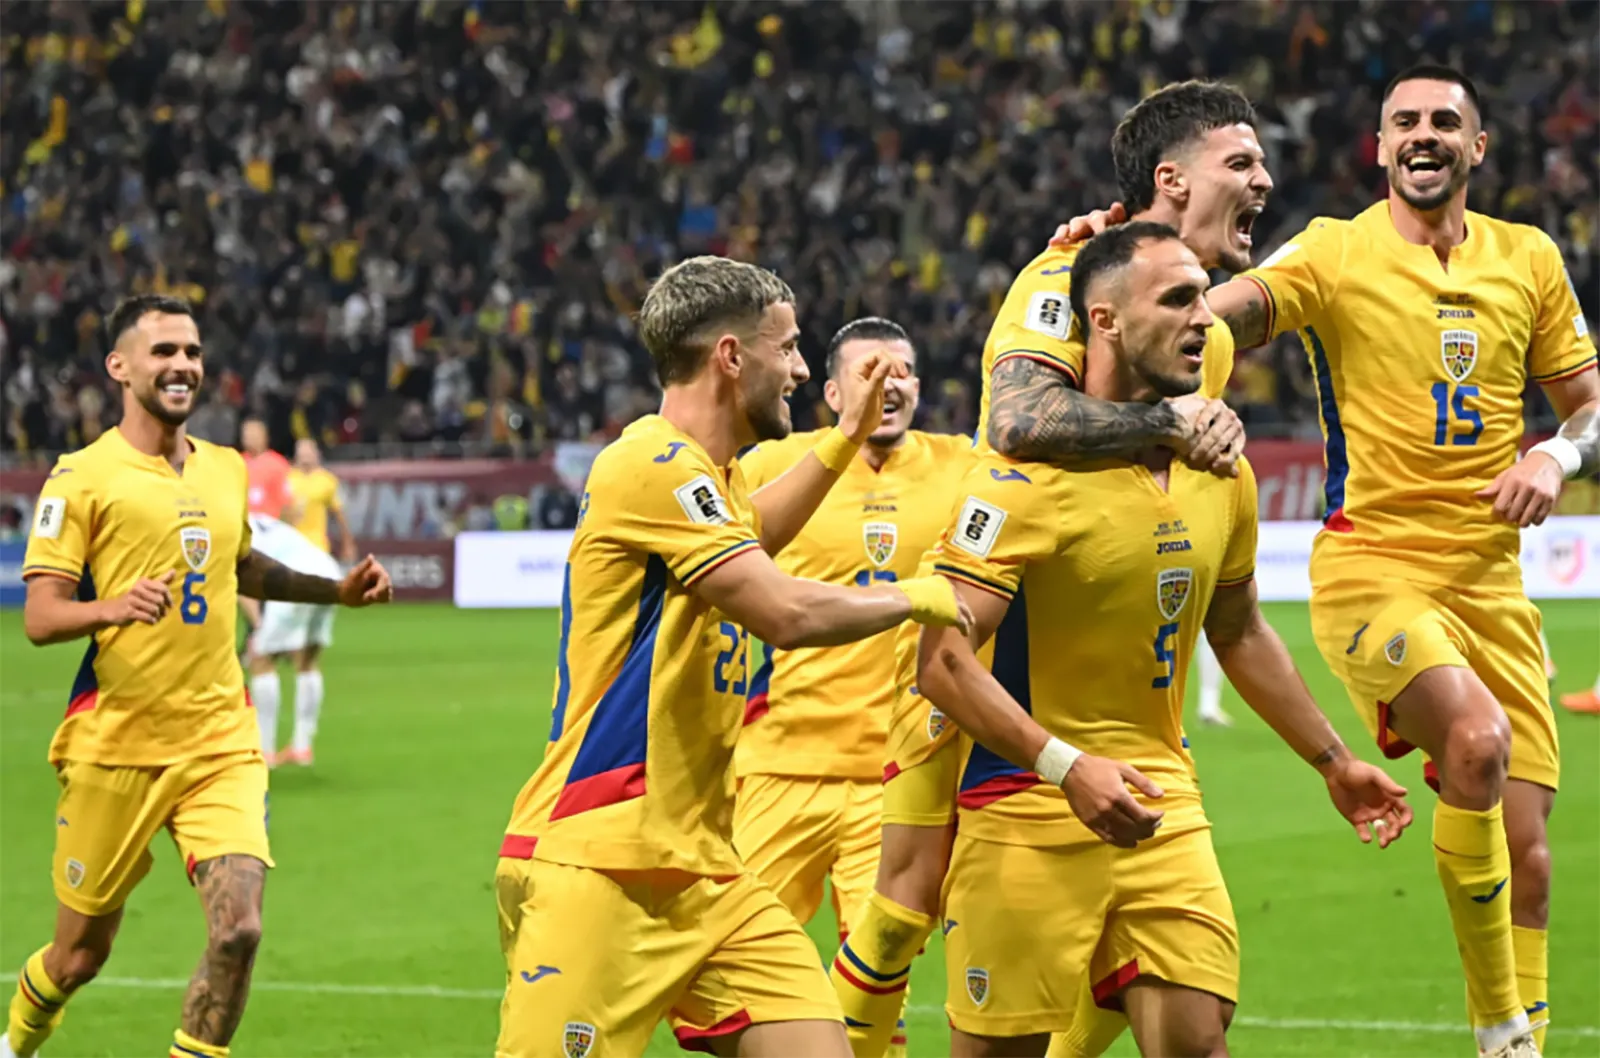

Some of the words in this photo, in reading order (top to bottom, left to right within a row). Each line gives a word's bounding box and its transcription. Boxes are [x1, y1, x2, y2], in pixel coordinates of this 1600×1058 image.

[1430, 382, 1484, 445] 15
[180, 571, 208, 624] 6
[1152, 622, 1180, 688] 5
